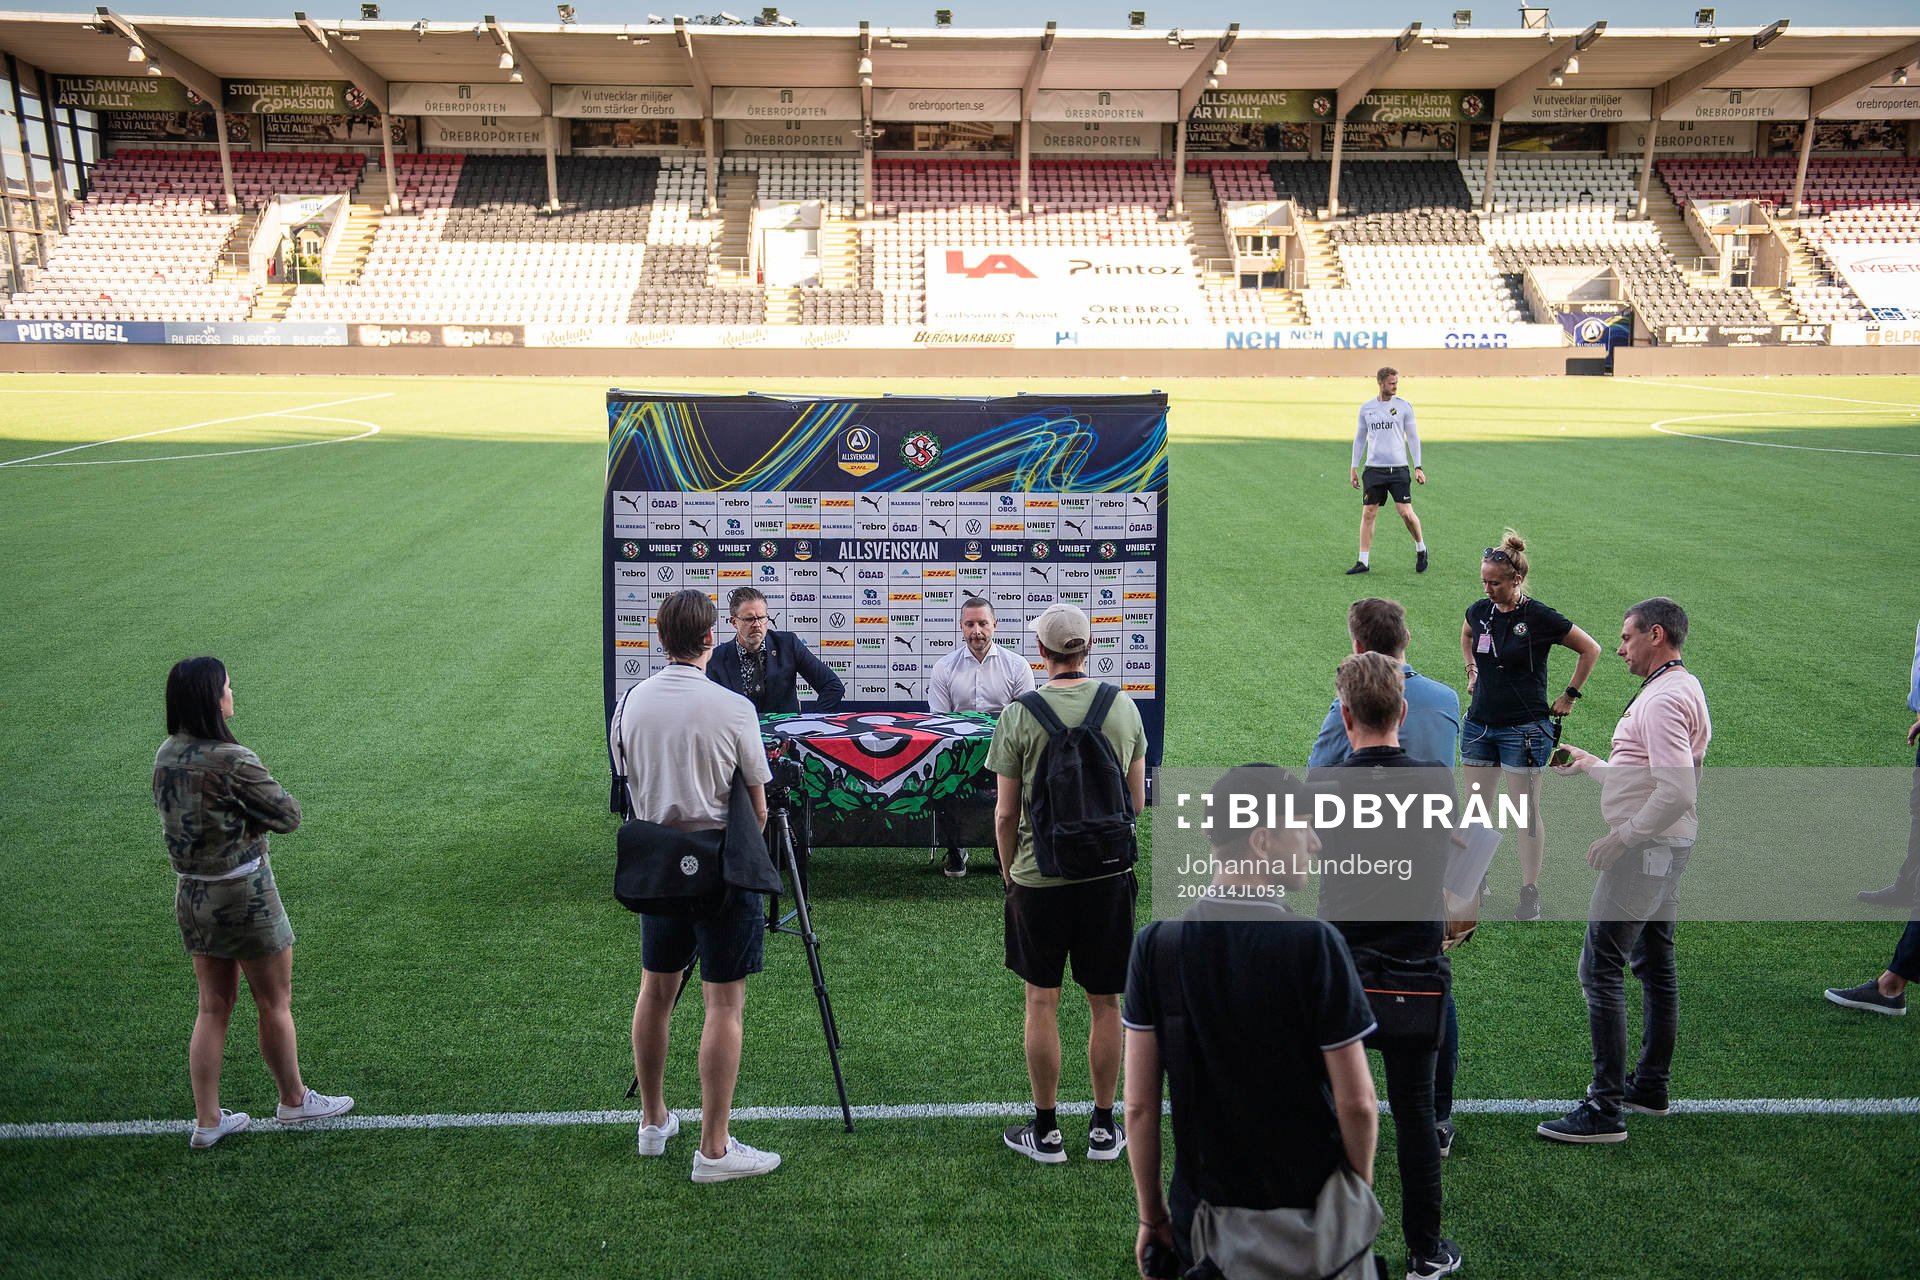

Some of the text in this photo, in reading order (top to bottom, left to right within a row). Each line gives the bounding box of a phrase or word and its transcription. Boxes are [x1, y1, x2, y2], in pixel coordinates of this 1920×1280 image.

[57, 79, 158, 93] TILLSAMMANS
[230, 84, 334, 98] STOLTHET, HJÄRTA
[59, 91, 133, 107] ÄR VI ALLT.
[582, 91, 673, 104] Vi utvecklar miljöer
[1201, 94, 1287, 105] ILLSAMMANS
[1359, 94, 1452, 107] TOLTHET, HJÄRTA
[1533, 95, 1622, 107] Vi utvecklar miljöer
[284, 98, 335, 111] PASSION
[425, 102, 506, 112] ÖREBROPORTEN
[581, 106, 601, 114] som
[604, 104, 638, 114] stärker
[108, 111, 175, 121] TILLSAMMANS
[747, 106, 826, 116] ÖREBROPORTEN
[1065, 108, 1144, 118] ÖREBROPORTEN
[1193, 104, 1262, 119] ÄR VI ALLT.
[1402, 107, 1451, 118] PASSION
[1531, 107, 1623, 118] som stärker Örebro
[1695, 107, 1775, 117] ÖREBROPORTEN
[266, 114, 333, 124] TILLSAMMANS
[122, 121, 133, 130] VI
[281, 123, 291, 133] VI
[1325, 123, 1389, 132] TILSAMMANS
[440, 129, 540, 142] ÖREBROPORTEN
[745, 134, 842, 146] ÖREBROPORTEN
[1043, 134, 1141, 147] ÖREBROPORTEN
[1637, 134, 1735, 147] ÖEBROPORTEN
[1069, 259, 1184, 275] Printoz
[1290, 330, 1323, 340] NCH
[1333, 331, 1388, 348] NCH
[1666, 326, 1709, 342] FLEX
[1780, 326, 1826, 342] FLEX
[1226, 331, 1280, 349] NCH
[1371, 421, 1394, 430] notar
[651, 497, 678, 508] ÖBAB
[892, 521, 918, 531] ÖBAB
[1129, 521, 1153, 532] ÖBAB
[649, 544, 682, 552] UNIBET
[718, 544, 751, 552] UNIBET
[839, 542, 939, 560] ALLSVENSKAN
[991, 544, 1023, 552] UNIBET
[1059, 545, 1091, 553] UNIBET
[1126, 543, 1156, 551] UNIBET
[859, 568, 884, 579] ÖBAB
[1094, 568, 1122, 576] UNIBET
[790, 591, 816, 602] ÖBAB
[1027, 591, 1053, 602] ÖBAB
[892, 661, 917, 671] ÖBAB
[1126, 660, 1151, 670] ÖBAB
